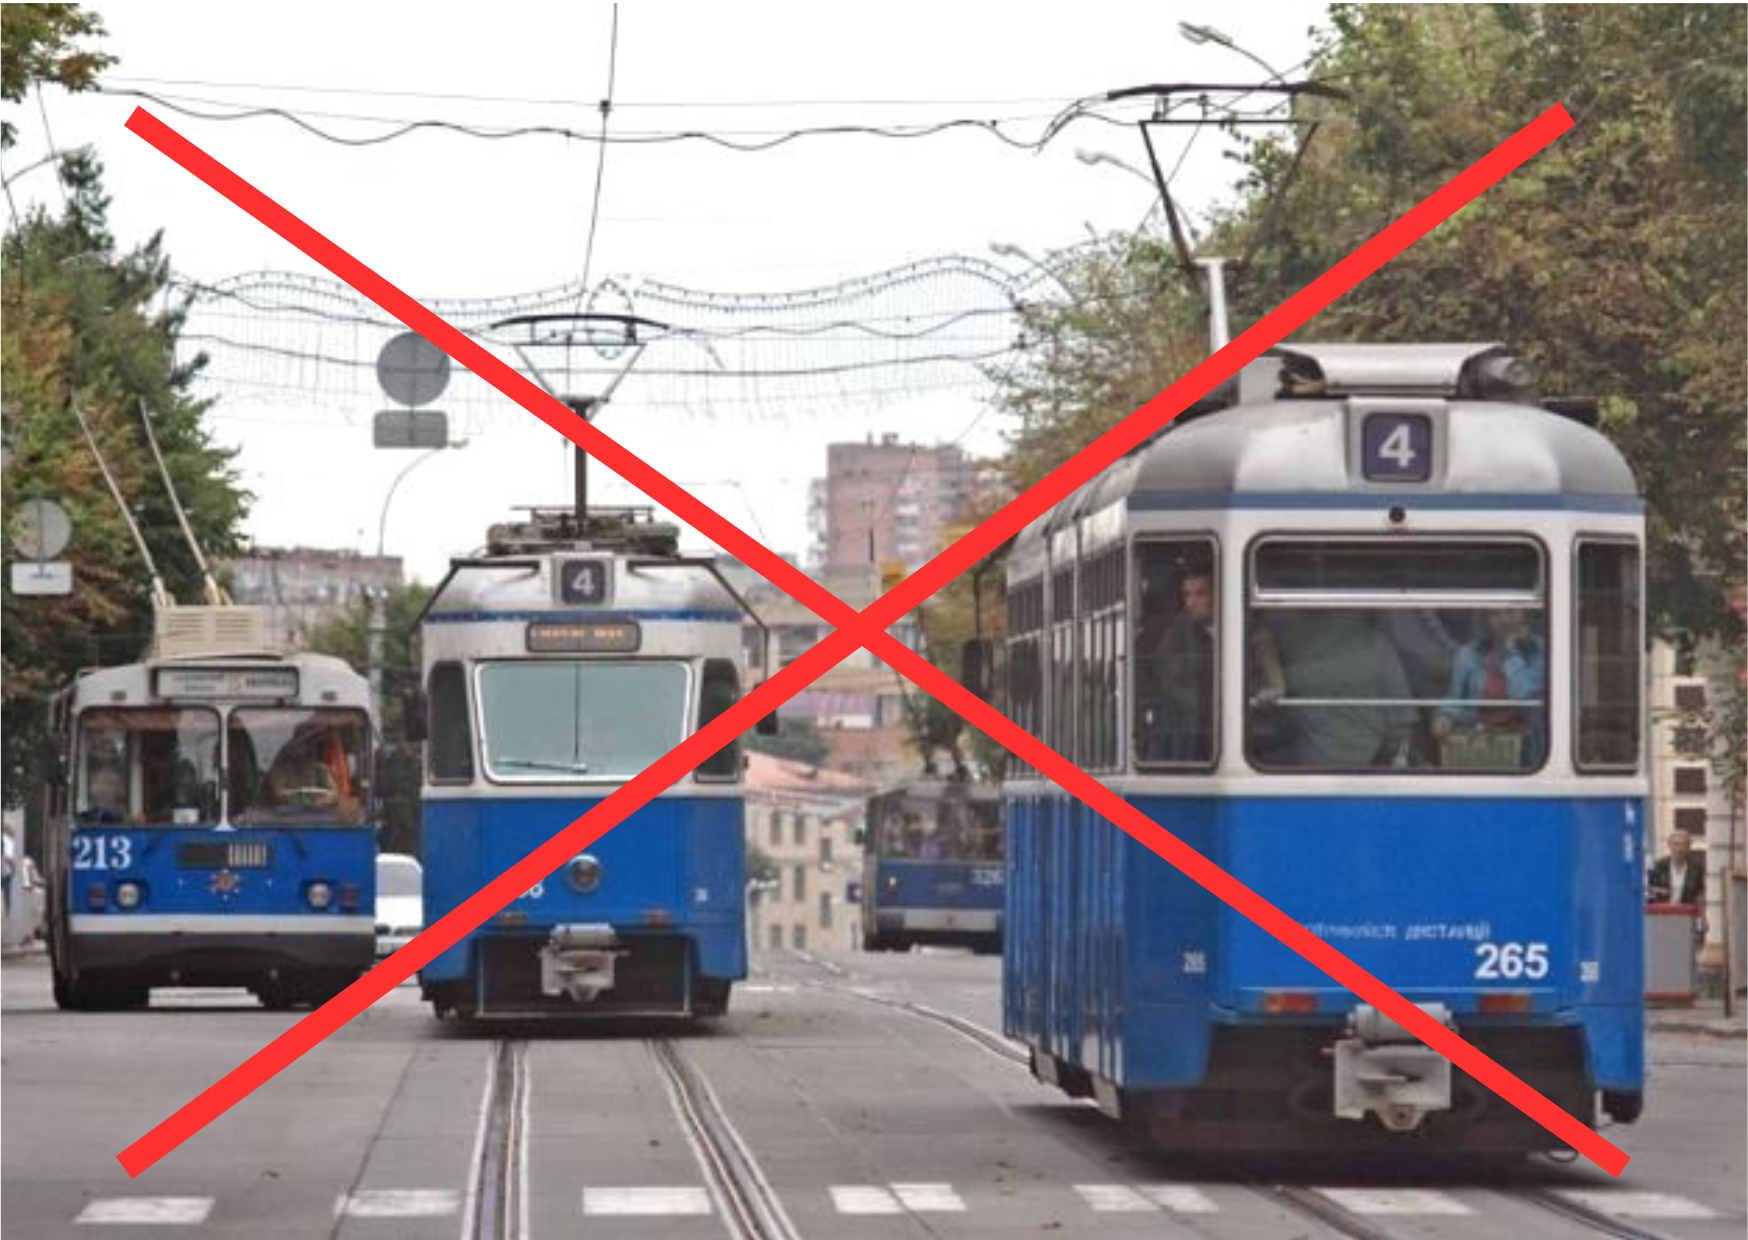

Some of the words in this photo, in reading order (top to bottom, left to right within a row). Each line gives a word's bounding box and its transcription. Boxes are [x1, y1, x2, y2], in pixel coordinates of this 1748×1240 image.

[1379, 423, 1416, 468] 4
[572, 568, 596, 595] 4
[73, 835, 132, 870] 213
[1475, 941, 1550, 980] 265
